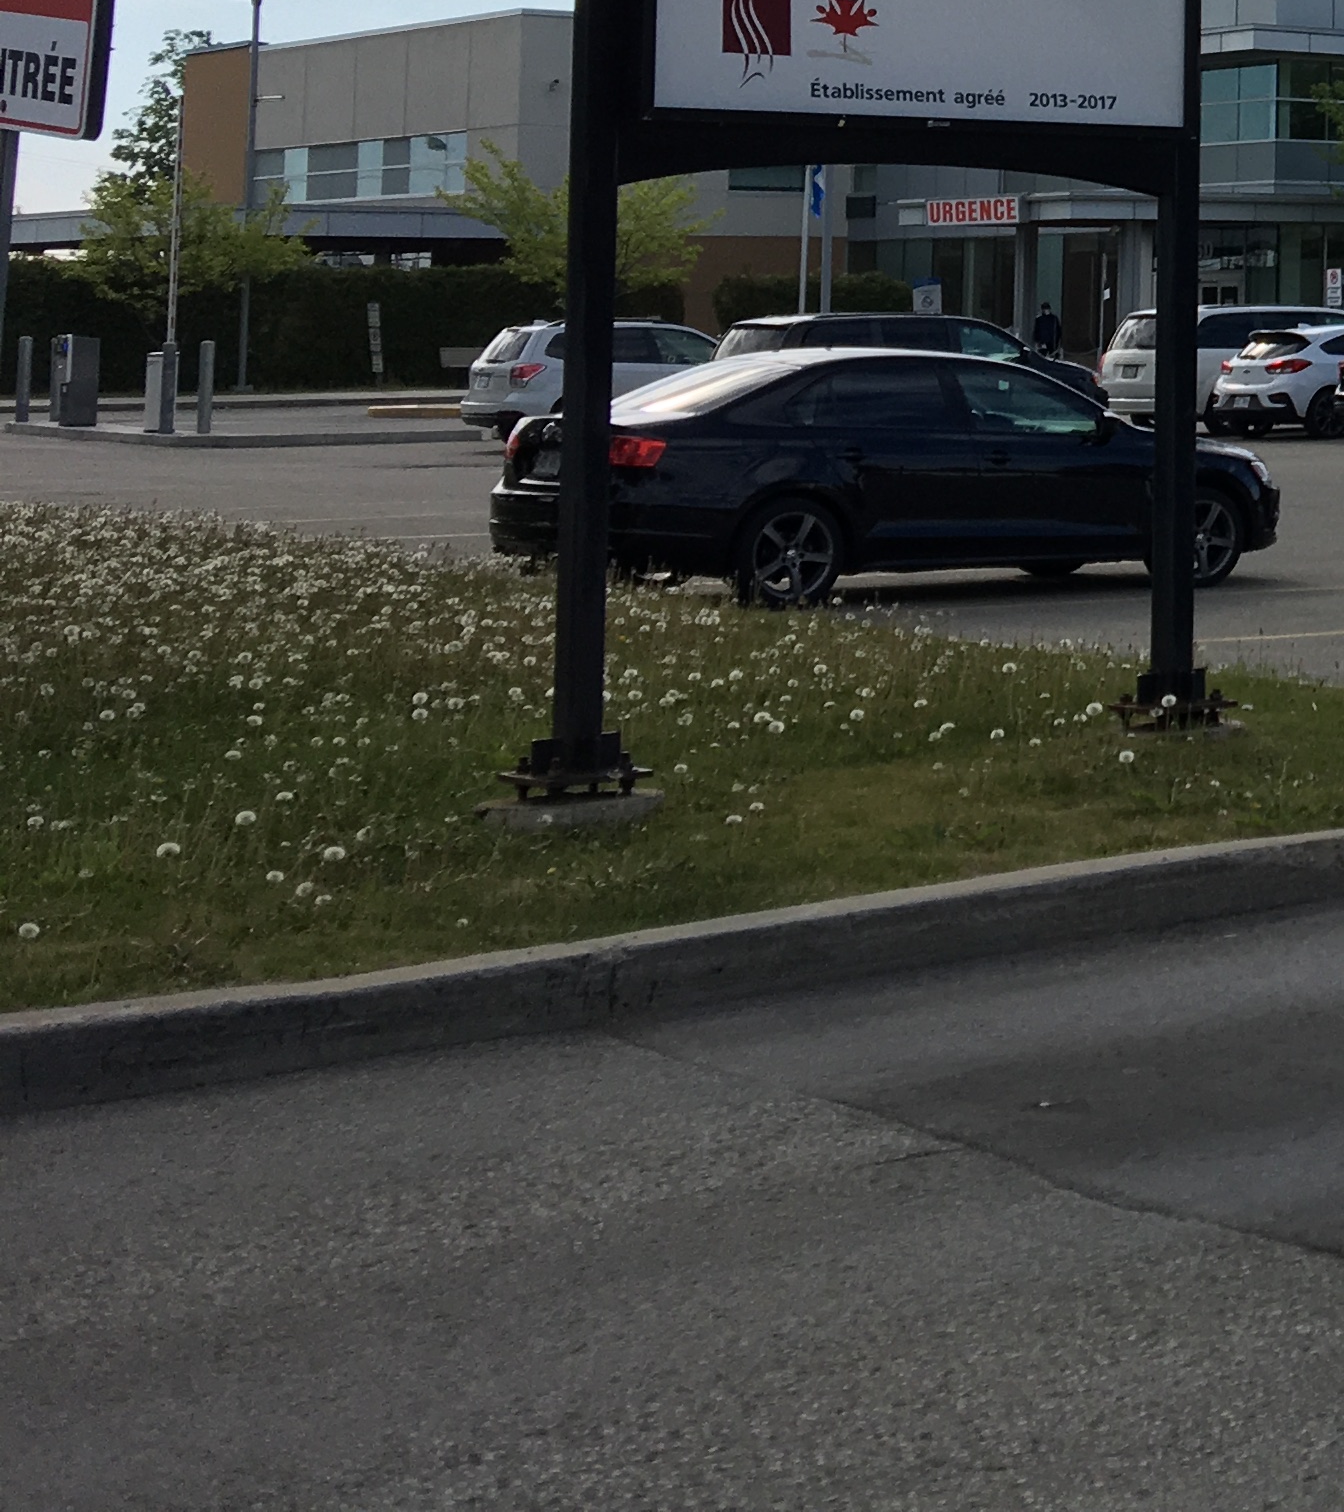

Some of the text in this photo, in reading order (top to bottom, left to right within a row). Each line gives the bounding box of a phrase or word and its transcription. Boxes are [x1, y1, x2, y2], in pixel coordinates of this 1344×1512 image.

[810, 77, 1117, 110] Établissement agréé 2013-2017
[929, 198, 1017, 223] URGENCE
